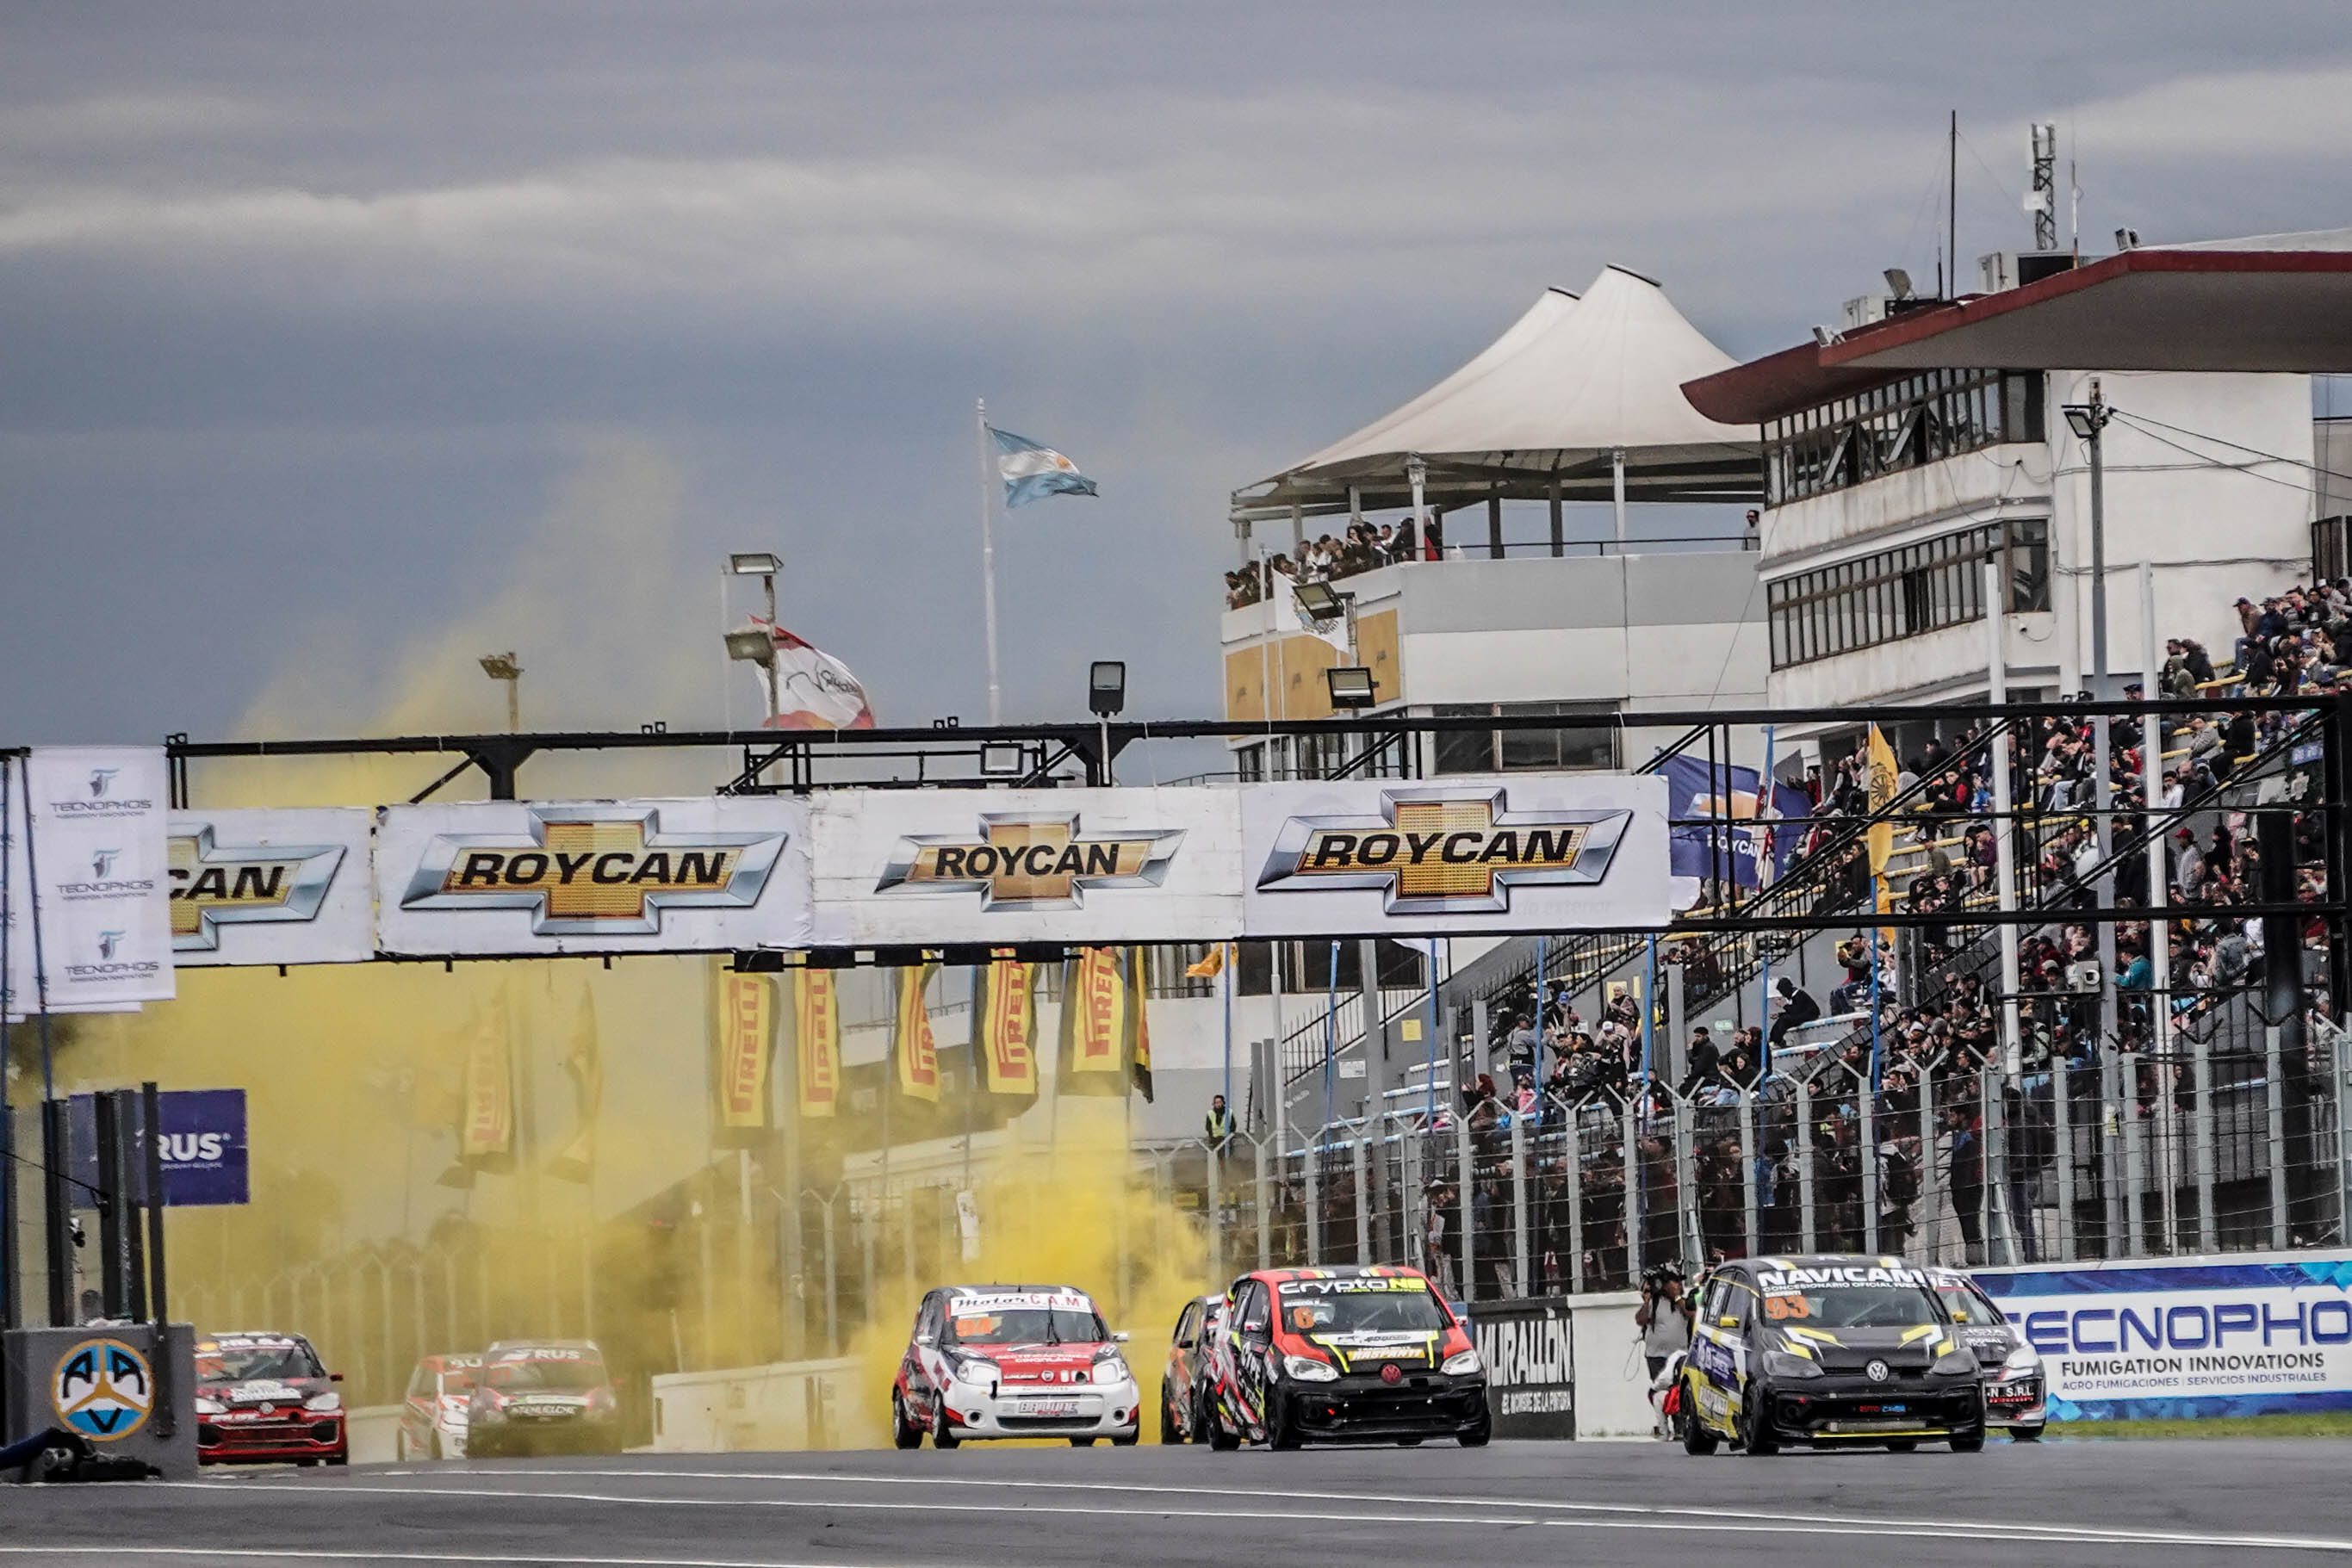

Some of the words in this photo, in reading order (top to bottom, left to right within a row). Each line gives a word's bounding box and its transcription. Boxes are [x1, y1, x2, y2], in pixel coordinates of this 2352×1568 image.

[50, 800, 152, 812] TECNOPHOS
[1313, 829, 1573, 867] ROYCAN
[458, 852, 727, 885] ROYCAN
[934, 843, 1120, 878] ROYCAN
[57, 880, 153, 894] TECNOPHOS
[65, 961, 158, 976] TECNOPHOS
[1757, 1267, 1926, 1287] NAVICAM
[1763, 1282, 1850, 1292] CONCESIONARIO
[1766, 1295, 1809, 1319] 93
[2062, 1359, 2182, 1377] FUMIGATION
[2190, 1352, 2324, 1372] INNOVATIONS
[2062, 1381, 2094, 1391] AGRO
[2096, 1377, 2179, 1390] FUMIGACIONES
[2187, 1374, 2245, 1385] SERVICIOS
[2247, 1371, 2327, 1385] INDUSTRIALES
